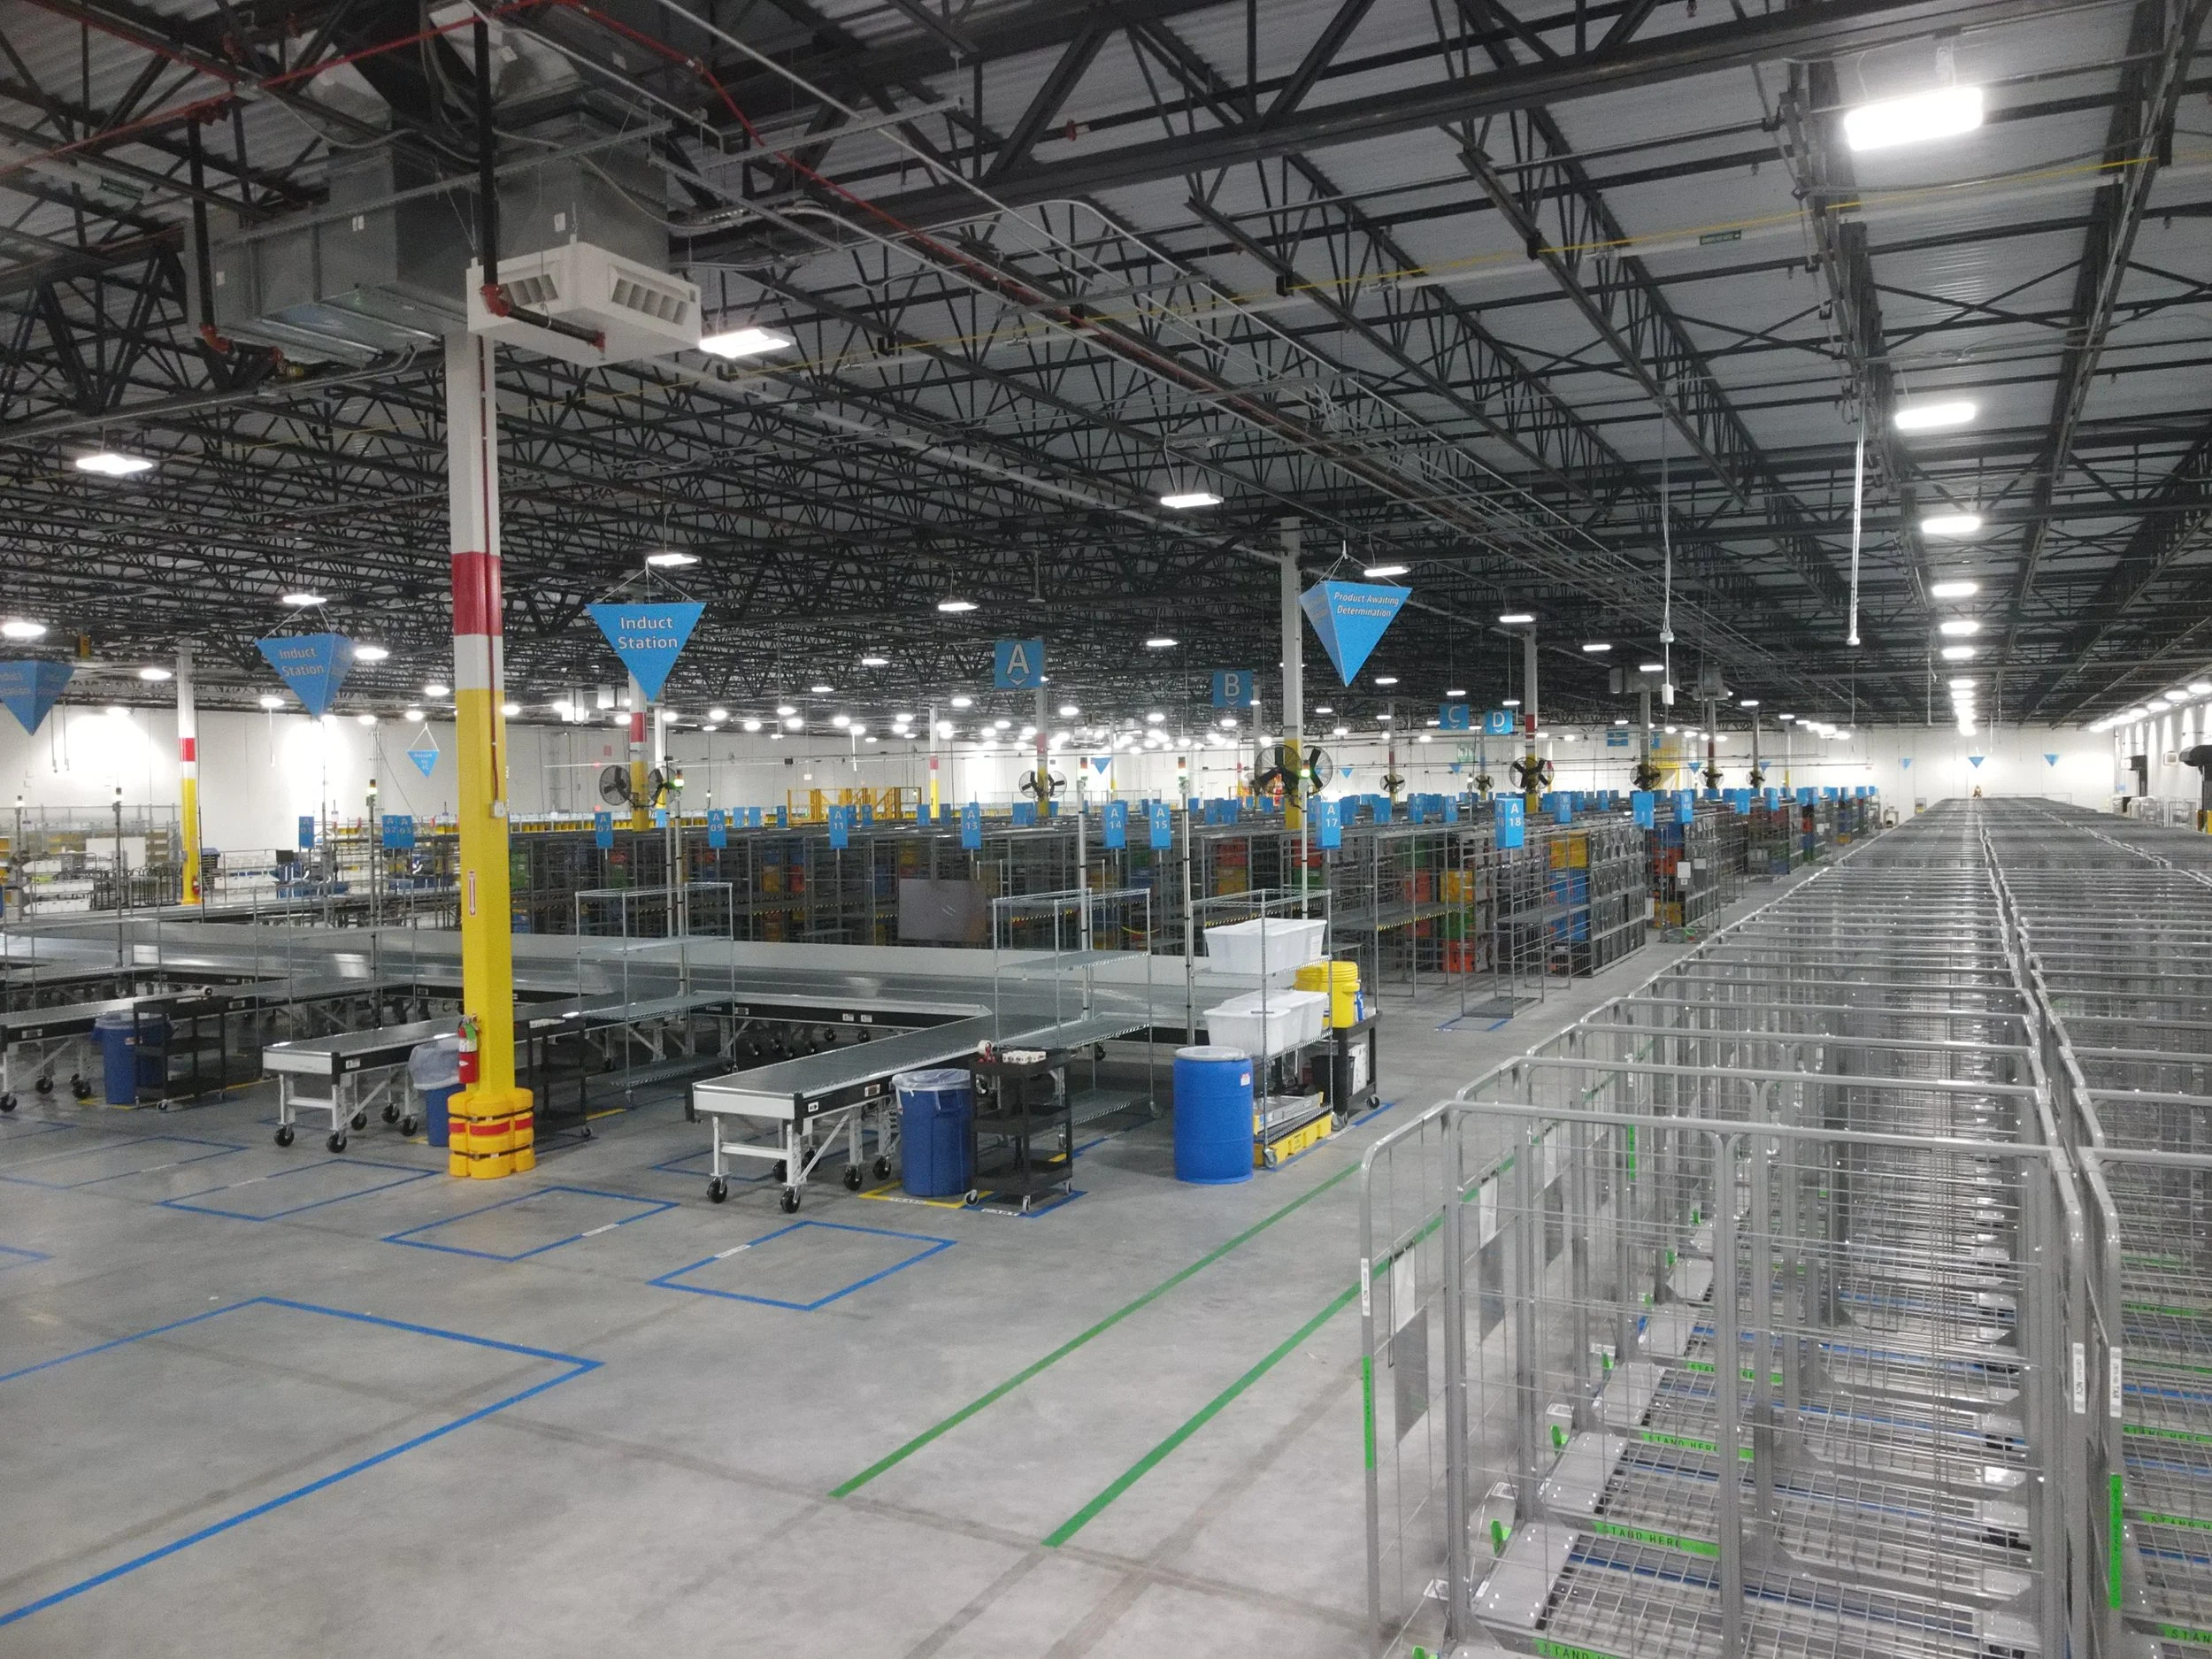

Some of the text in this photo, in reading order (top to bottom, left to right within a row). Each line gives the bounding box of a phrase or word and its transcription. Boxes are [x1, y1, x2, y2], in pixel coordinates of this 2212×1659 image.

[1334, 591, 1399, 607] Product Awaiting
[1337, 605, 1391, 618] Determination
[620, 616, 673, 630] Induct
[618, 635, 678, 649] Station
[279, 647, 317, 660] Induct
[1007, 643, 1030, 674] A
[282, 664, 325, 677] Station
[1225, 672, 1240, 697] B
[1448, 705, 1461, 723] C
[1493, 711, 1505, 727] D
[1110, 807, 1118, 818] A
[1156, 807, 1165, 818] A
[1327, 805, 1336, 815] A
[1511, 803, 1519, 814] A
[713, 812, 720, 822] A
[834, 810, 842, 820] A
[967, 810, 976, 819] A
[833, 822, 844, 831] 11
[966, 822, 978, 831] 13
[1110, 820, 1122, 830] 14
[1155, 820, 1168, 829] 15
[1325, 818, 1338, 828] 17
[1509, 817, 1522, 827] 18
[1648, 1434, 1684, 1447] STAND
